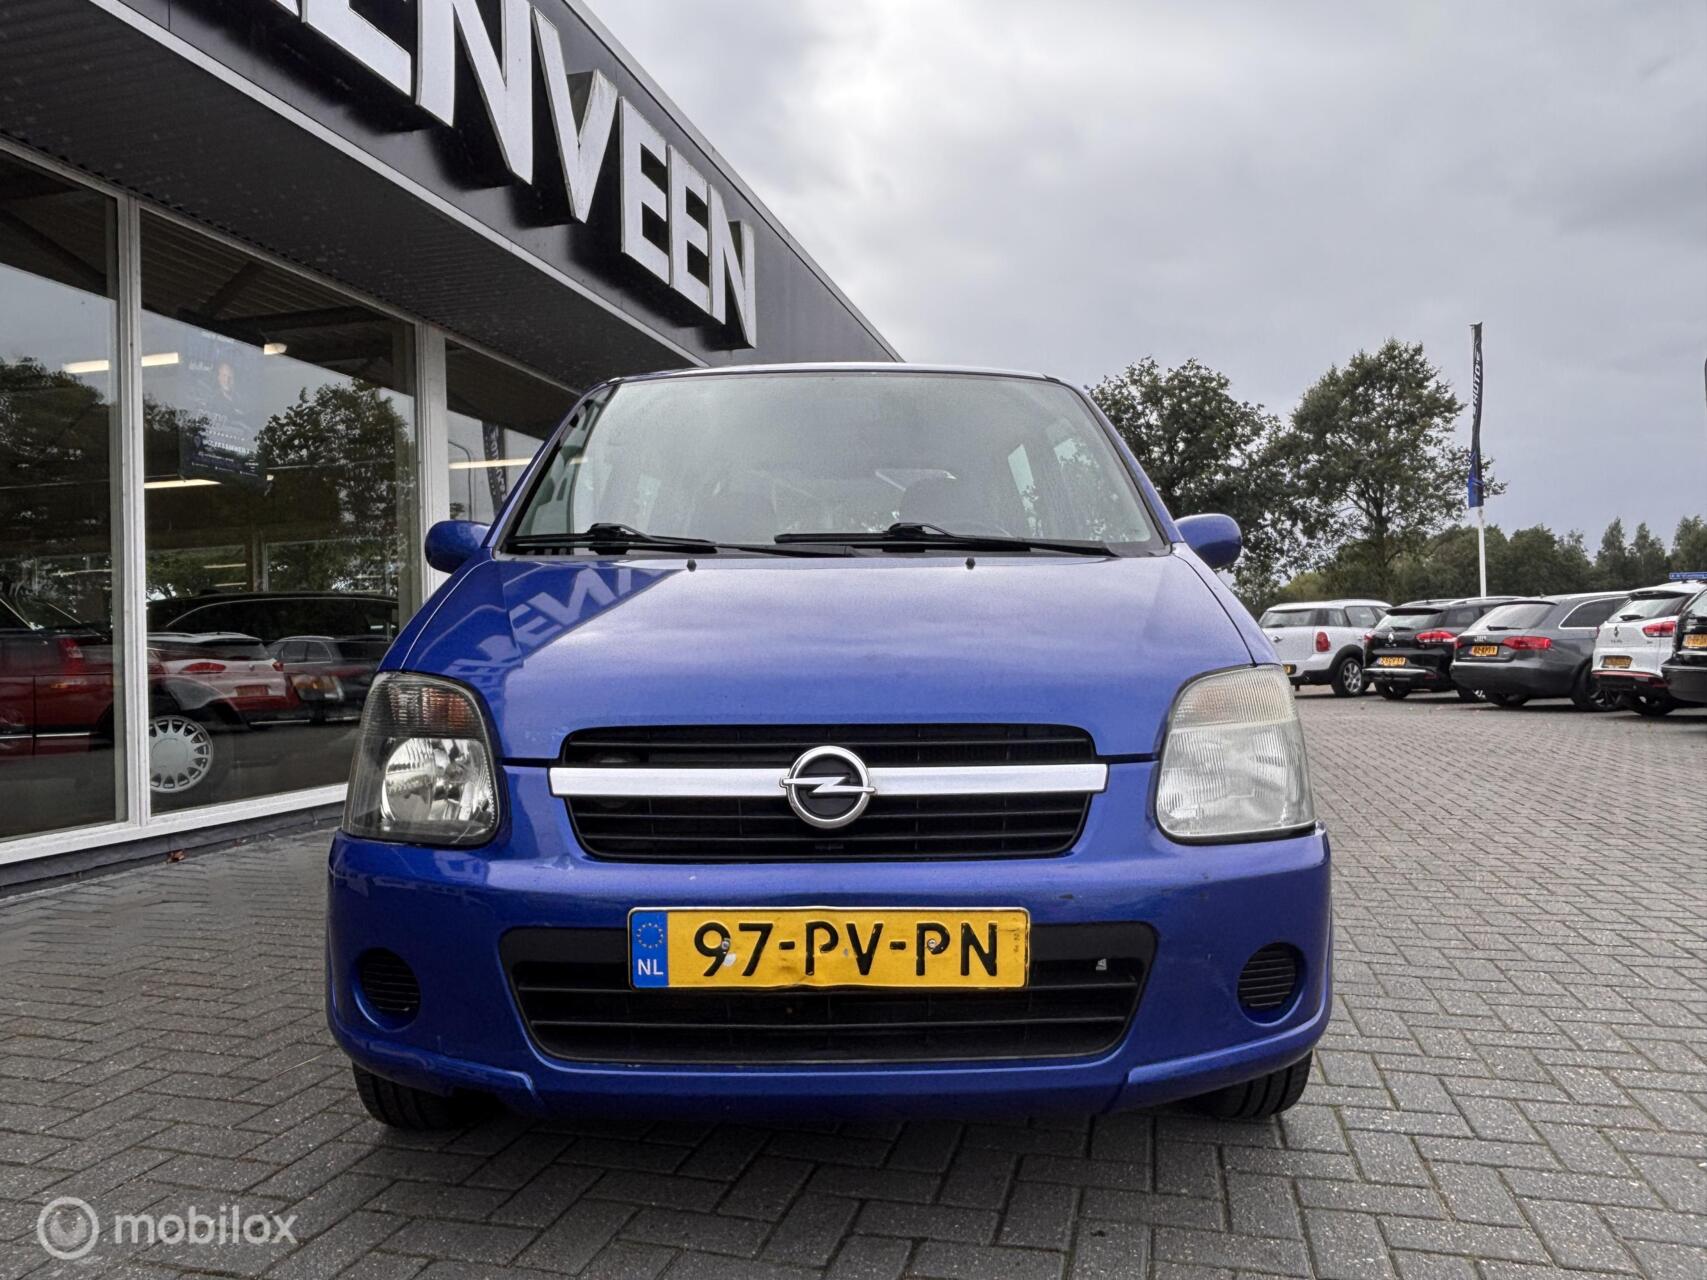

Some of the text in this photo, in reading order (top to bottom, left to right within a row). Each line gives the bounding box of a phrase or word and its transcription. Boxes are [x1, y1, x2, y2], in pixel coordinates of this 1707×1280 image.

[271, 0, 757, 348] NVEEN
[637, 958, 664, 976] NL
[694, 921, 998, 977] 97-PV-PN
